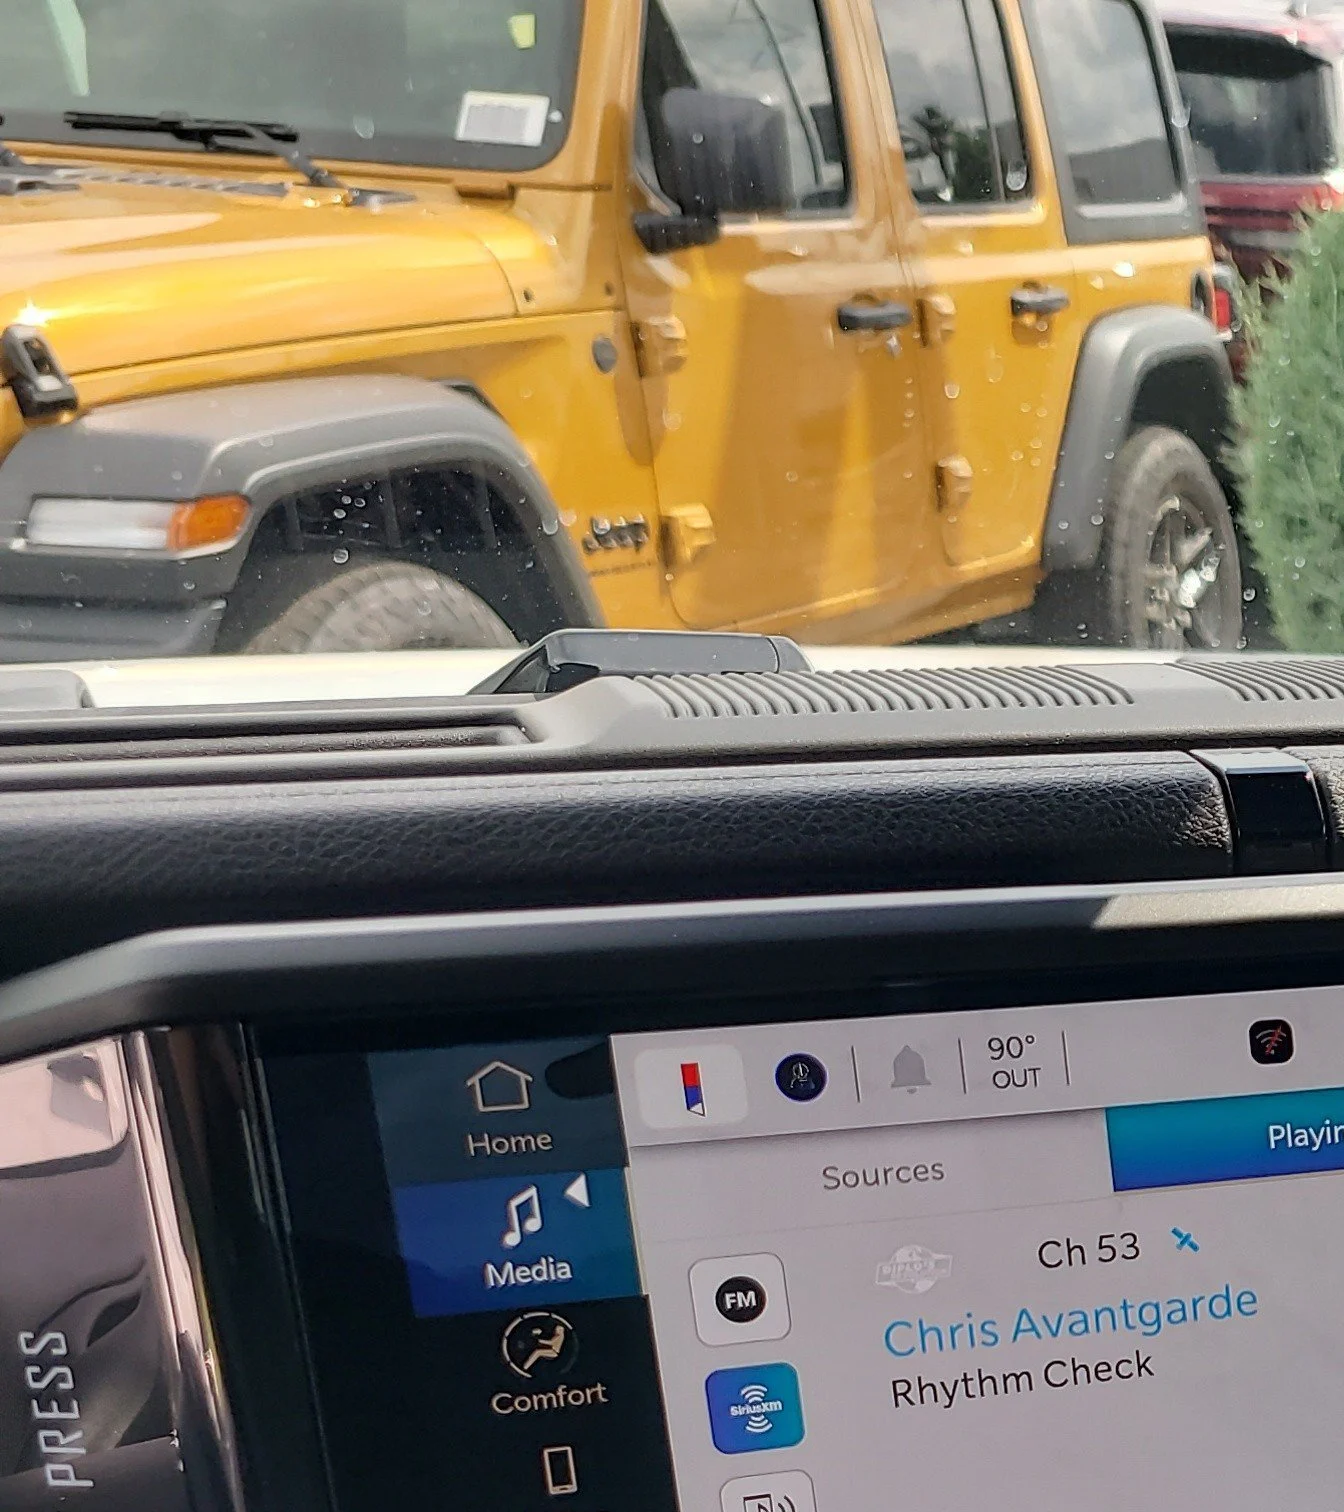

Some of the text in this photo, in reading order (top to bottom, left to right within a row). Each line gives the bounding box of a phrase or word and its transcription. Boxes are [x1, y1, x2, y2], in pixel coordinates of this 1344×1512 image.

[988, 1035, 1035, 1060] 90°
[992, 1068, 1041, 1089] OUT
[468, 1132, 552, 1157] Home
[822, 1159, 944, 1190] Sources
[1038, 1232, 1140, 1269] Ch 53
[483, 1257, 573, 1288] Media
[725, 1291, 756, 1310] FM
[884, 1284, 1259, 1358] Chris Avantgarde
[892, 1350, 1154, 1410] Rhythm Check
[19, 1330, 95, 1489] PRESS
[491, 1381, 608, 1416] Comfort
